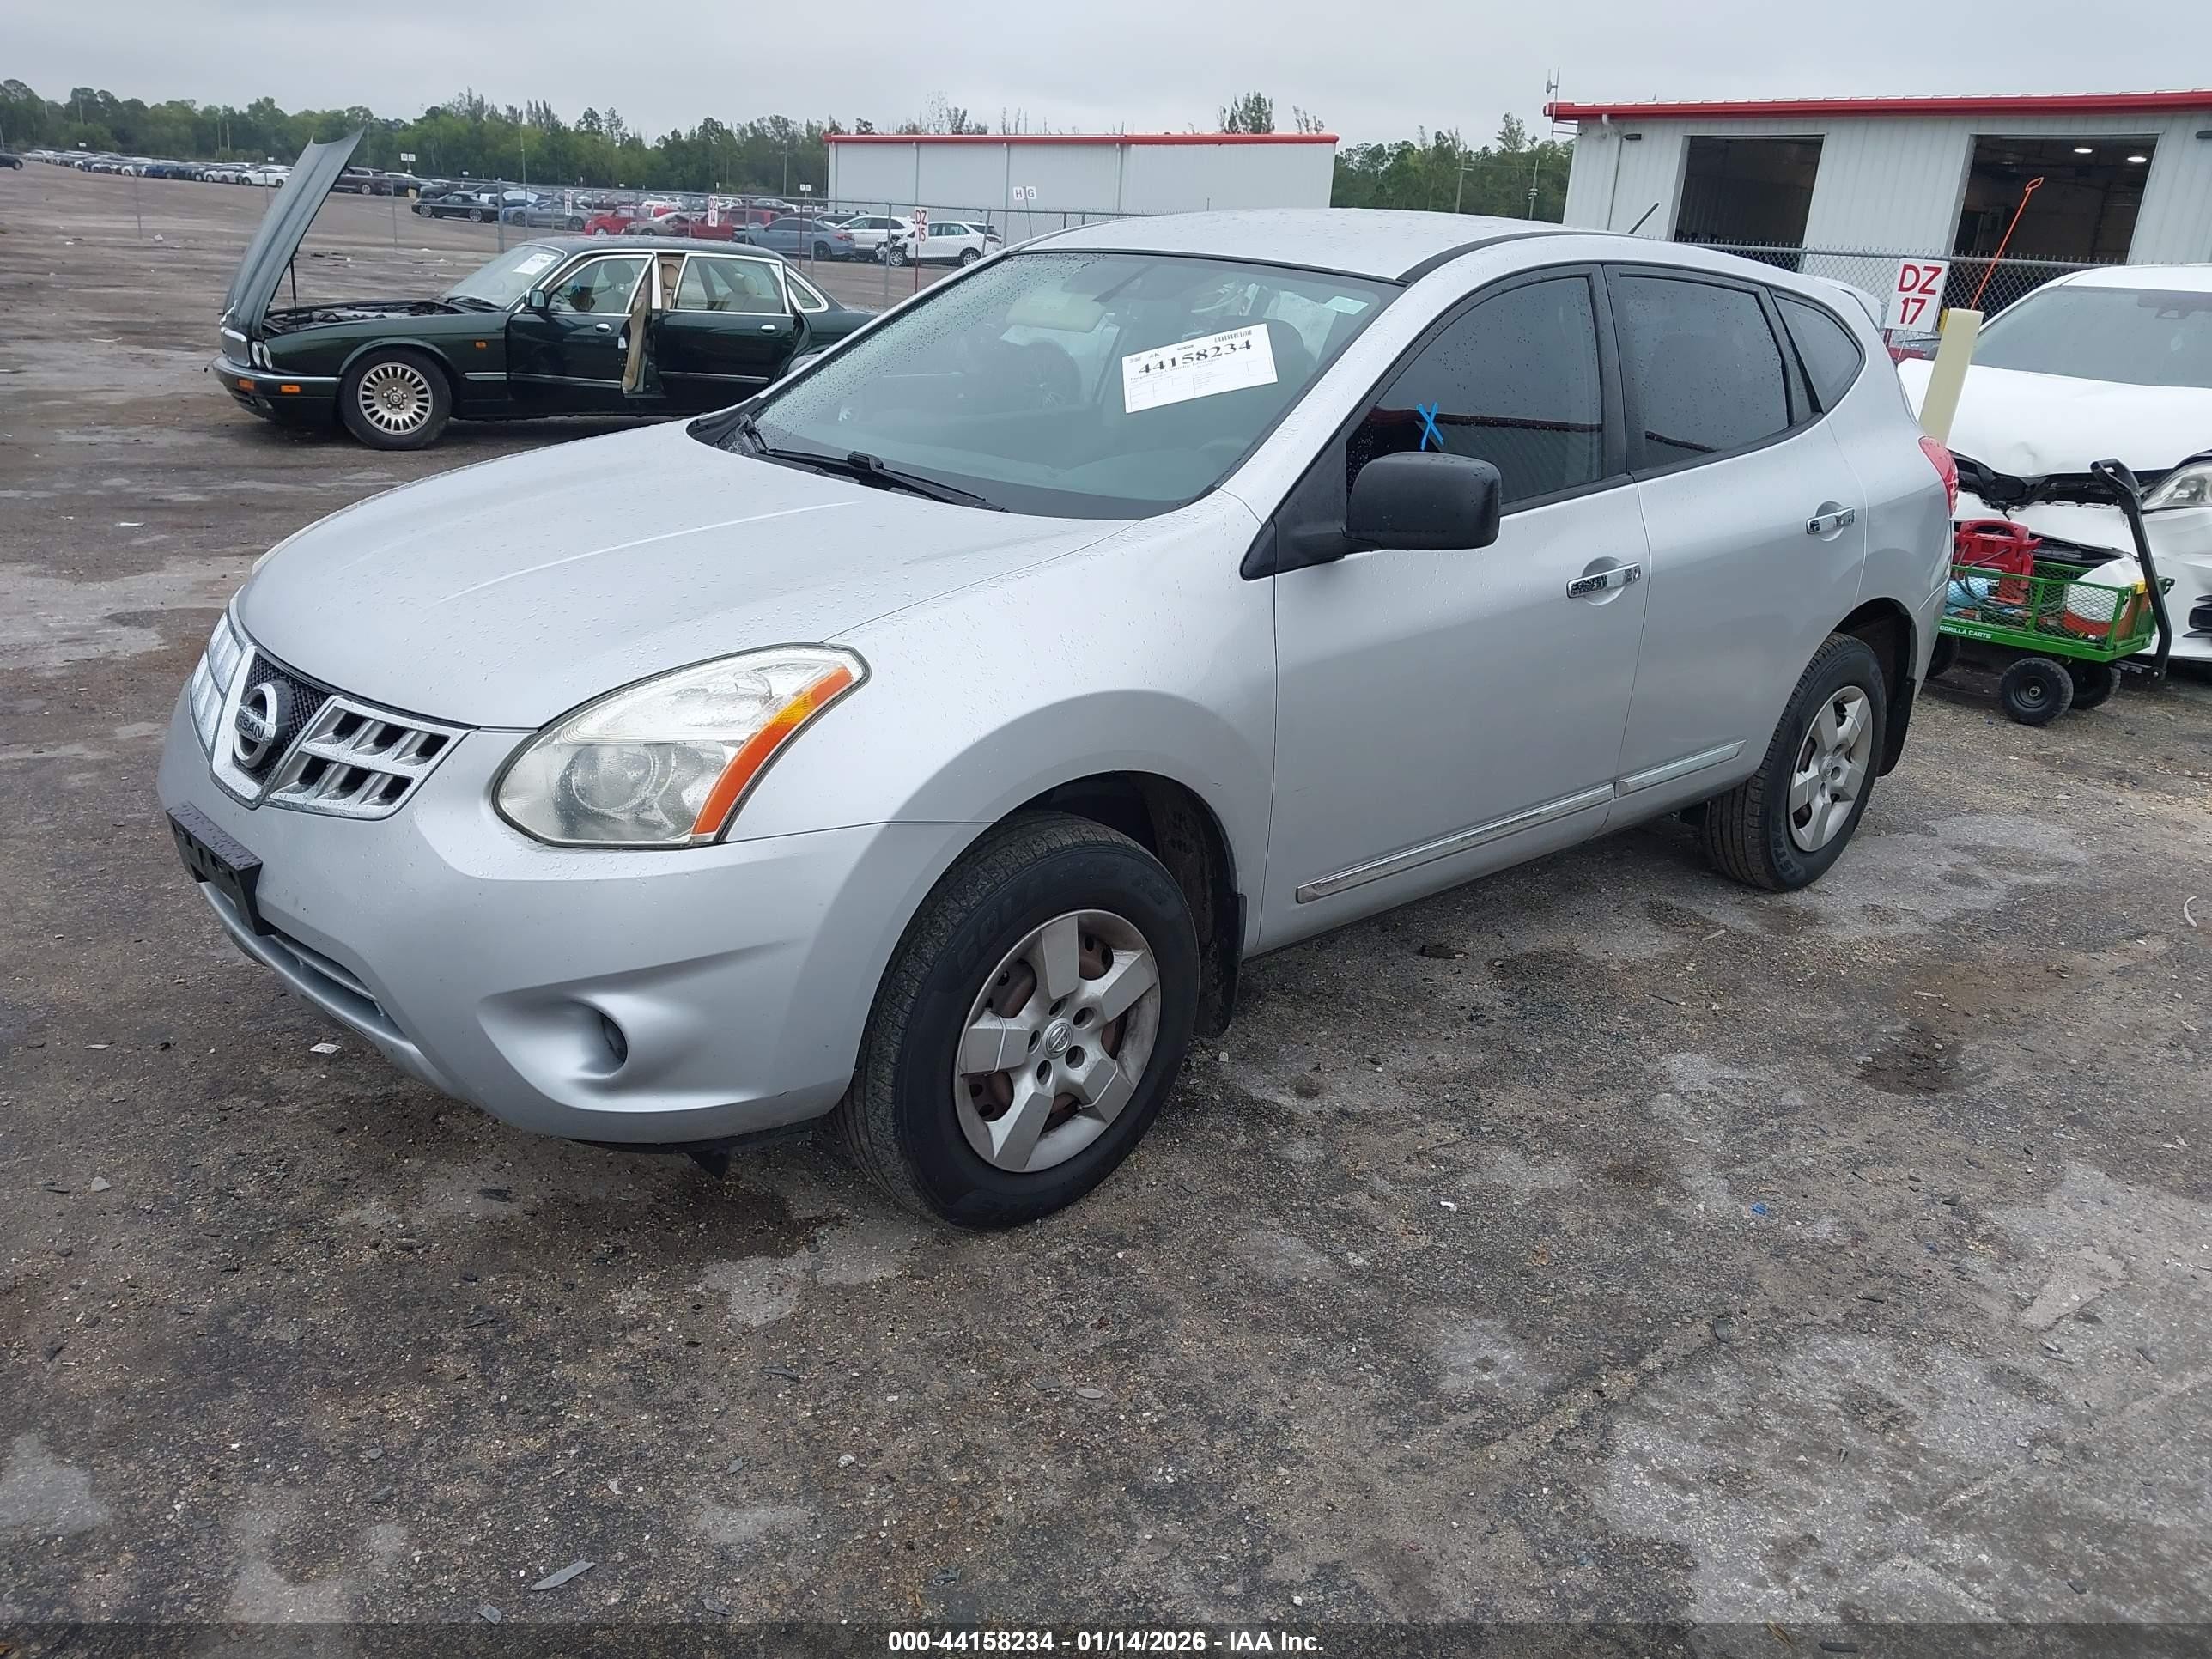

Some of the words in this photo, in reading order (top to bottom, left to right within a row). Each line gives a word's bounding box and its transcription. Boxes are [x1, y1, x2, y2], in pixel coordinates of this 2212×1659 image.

[1027, 188, 1035, 198] G
[915, 210, 927, 225] DZ
[918, 227, 926, 242] 15
[1898, 264, 1942, 295] DZ
[1899, 297, 1927, 325] 17
[1139, 339, 1252, 374] 44158234
[1939, 625, 1966, 635] GORILLA
[1968, 629, 1992, 639] CARTS
